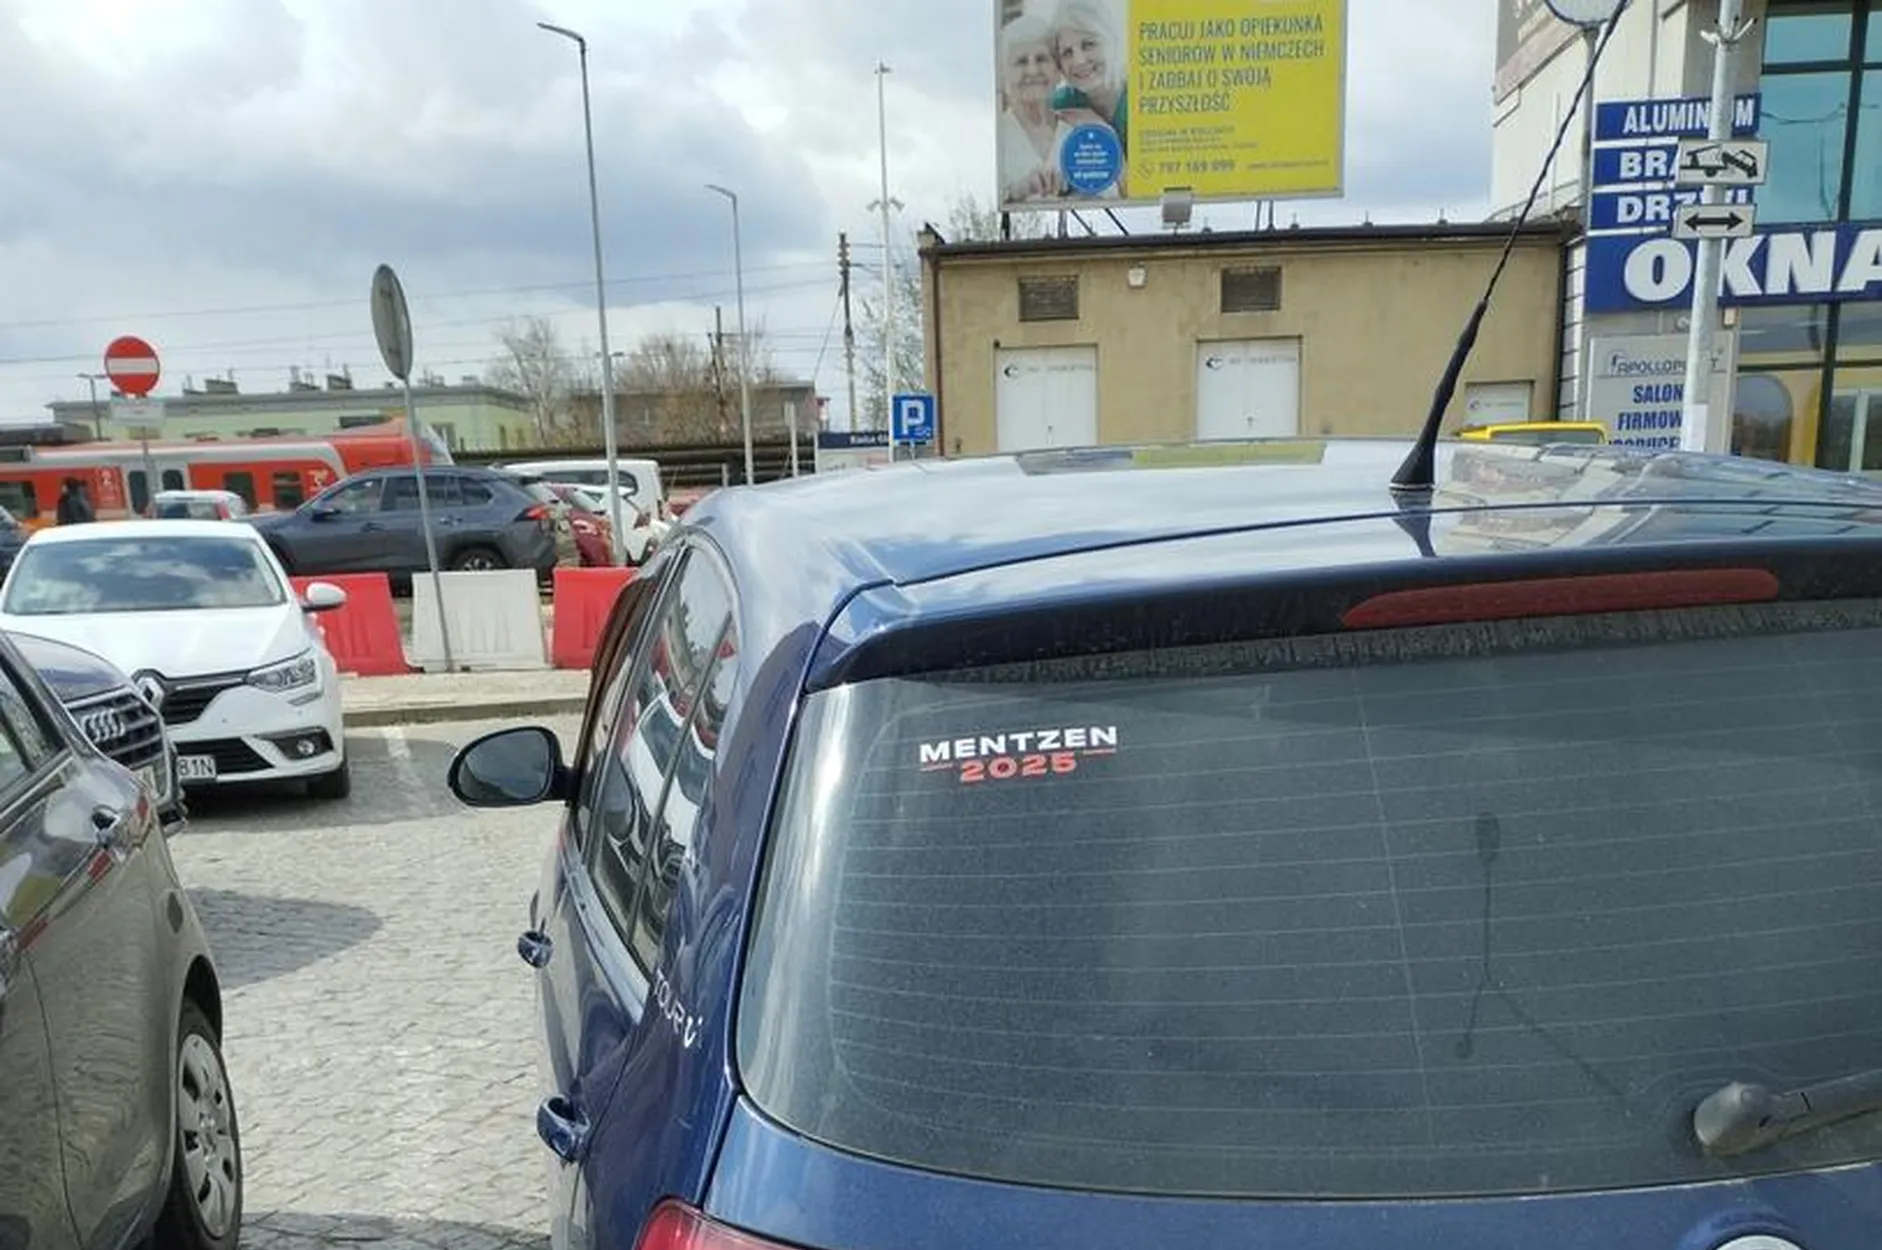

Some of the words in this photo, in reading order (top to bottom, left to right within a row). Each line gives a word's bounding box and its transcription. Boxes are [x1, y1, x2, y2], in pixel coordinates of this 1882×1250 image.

[1139, 21, 1194, 40] PRACUJ
[1200, 19, 1235, 39] JAKO
[1240, 14, 1323, 37] OPIEKUNKA
[1222, 44, 1235, 62] W
[1240, 39, 1325, 60] NIEMCZECH
[1149, 70, 1201, 89] ZADBAJ
[1207, 69, 1217, 87] O
[1622, 99, 1756, 135] ALUMINM
[1633, 383, 1685, 404] SALON
[902, 400, 925, 435] P
[920, 726, 1117, 762] MENTZEN
[960, 751, 1076, 782] 2025
